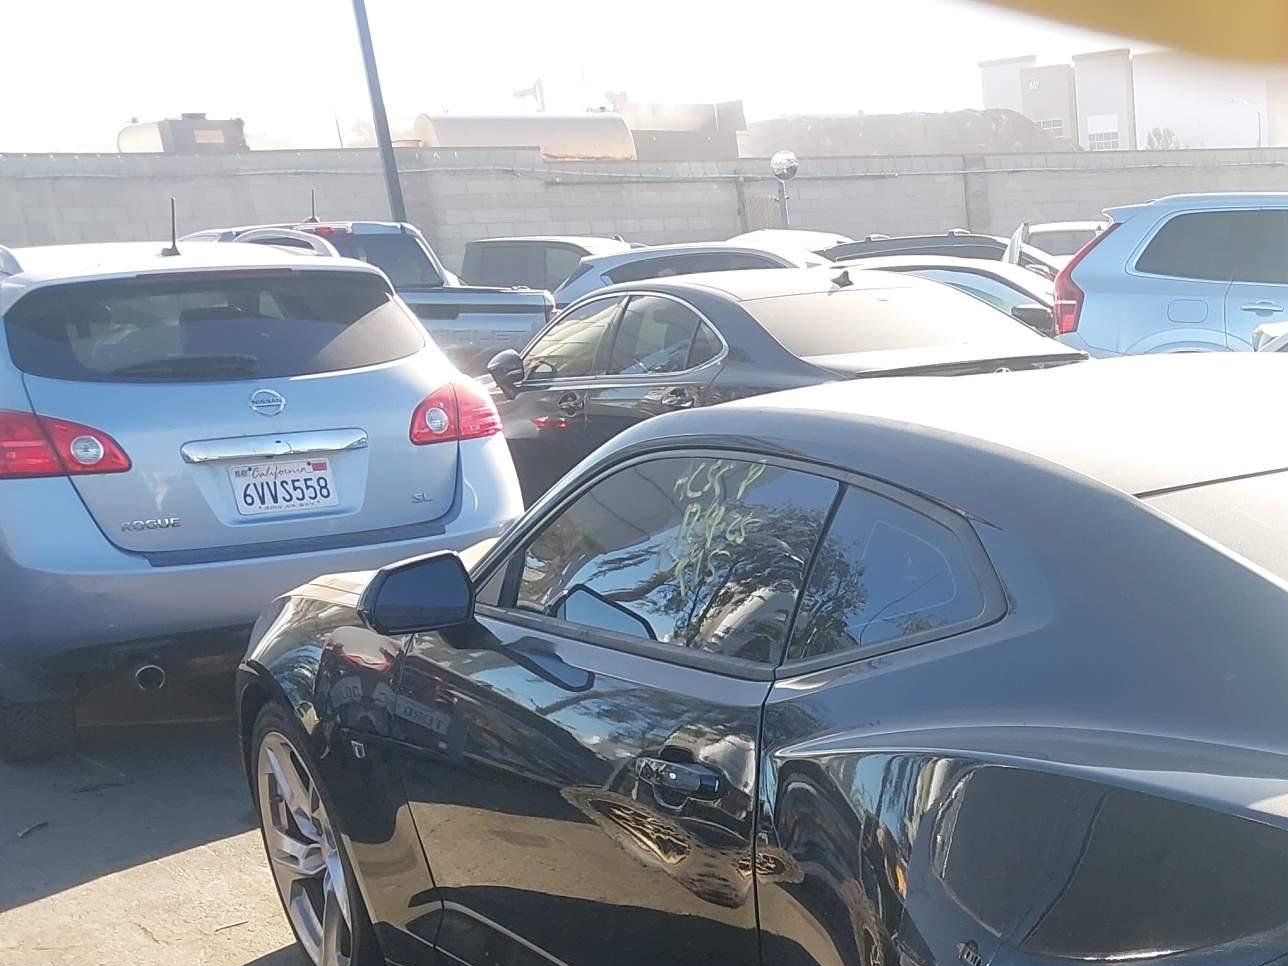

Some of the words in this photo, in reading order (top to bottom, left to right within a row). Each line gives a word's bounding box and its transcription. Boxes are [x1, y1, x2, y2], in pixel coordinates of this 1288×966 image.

[251, 465, 312, 479] California
[243, 476, 331, 507] 6VVS558
[121, 517, 182, 533] ROGUE
